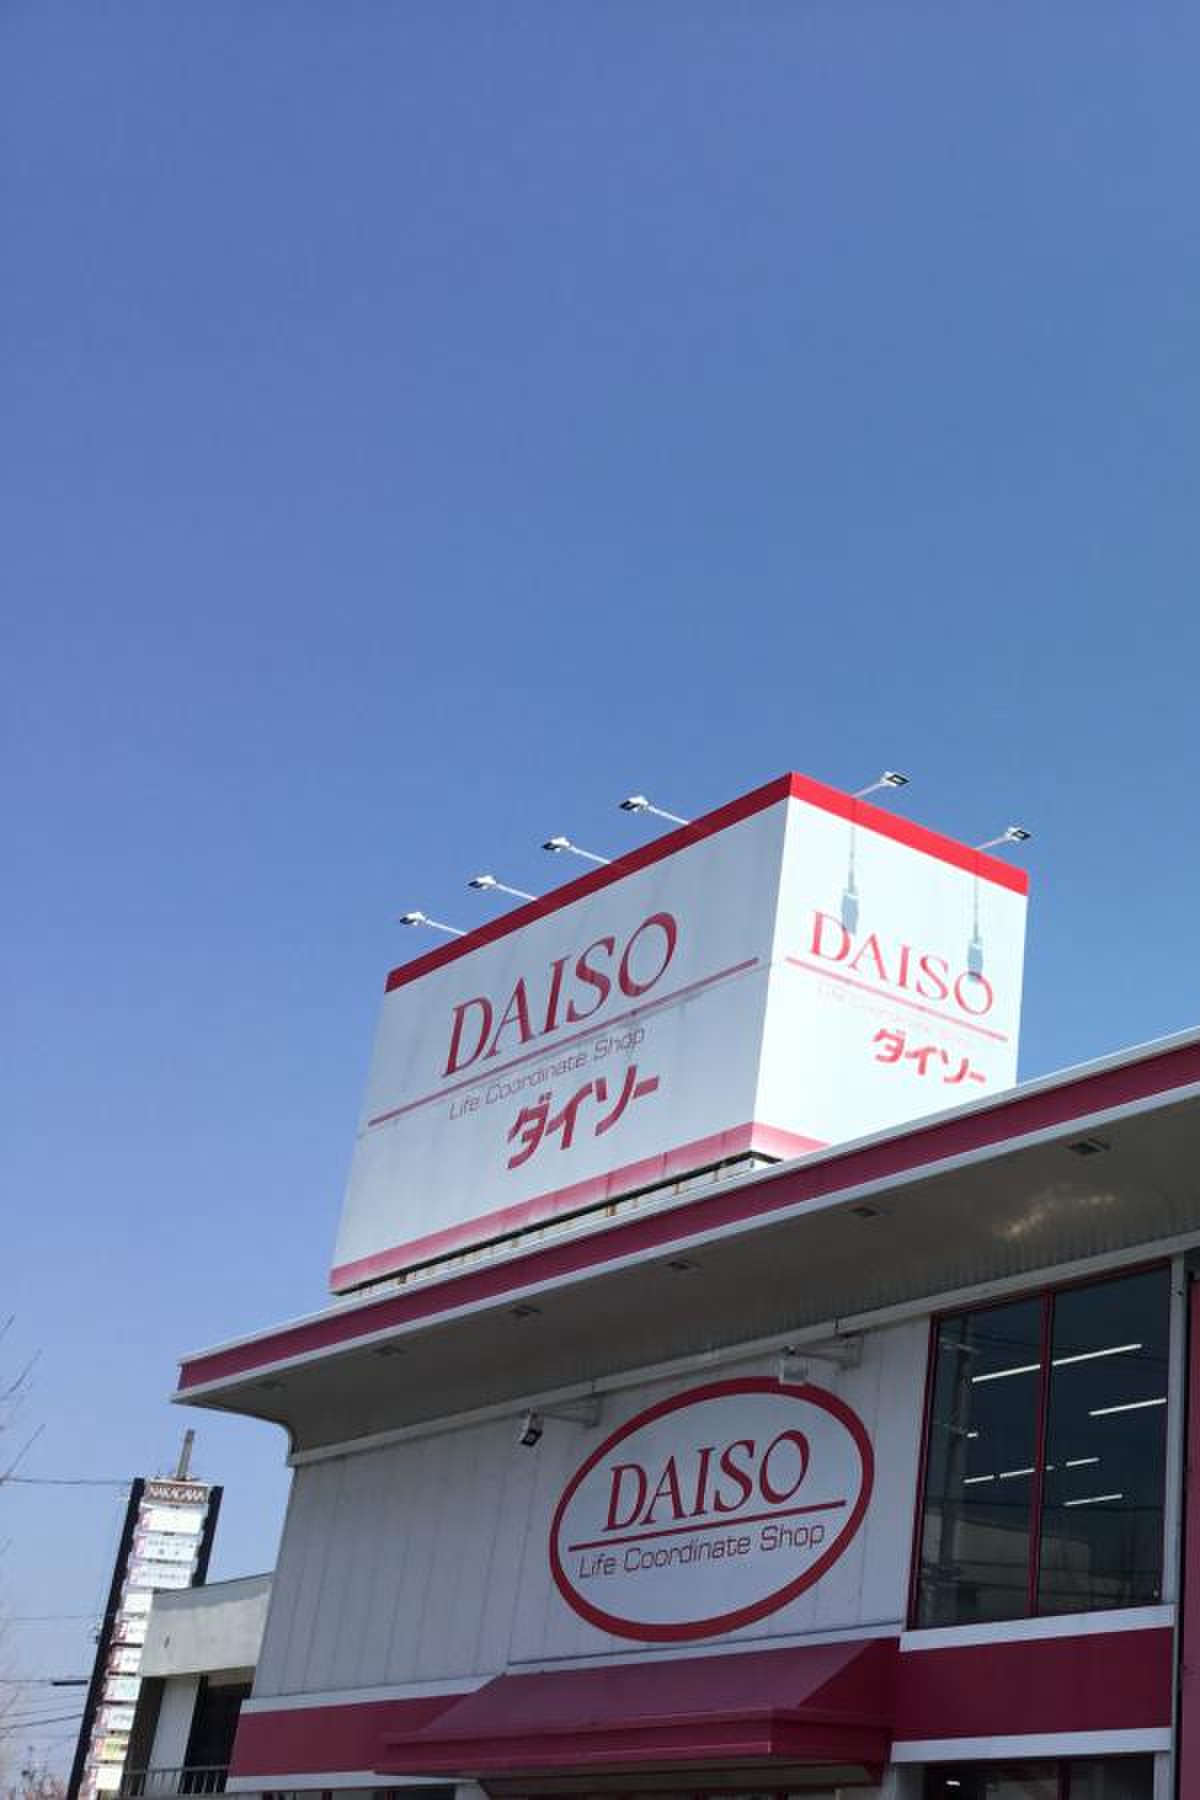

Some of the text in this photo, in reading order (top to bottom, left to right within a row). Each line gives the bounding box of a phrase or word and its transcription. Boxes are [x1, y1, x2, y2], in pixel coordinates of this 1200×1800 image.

[443, 911, 678, 1079] DAISO
[809, 911, 995, 1017] DAISO
[449, 1027, 646, 1121] Life Coordinate Shop
[872, 1028, 988, 1086] ダイソー
[507, 1064, 661, 1170] ダイソー
[603, 1429, 810, 1533] DAISO
[579, 1524, 826, 1579] Life Coordinate Shop
